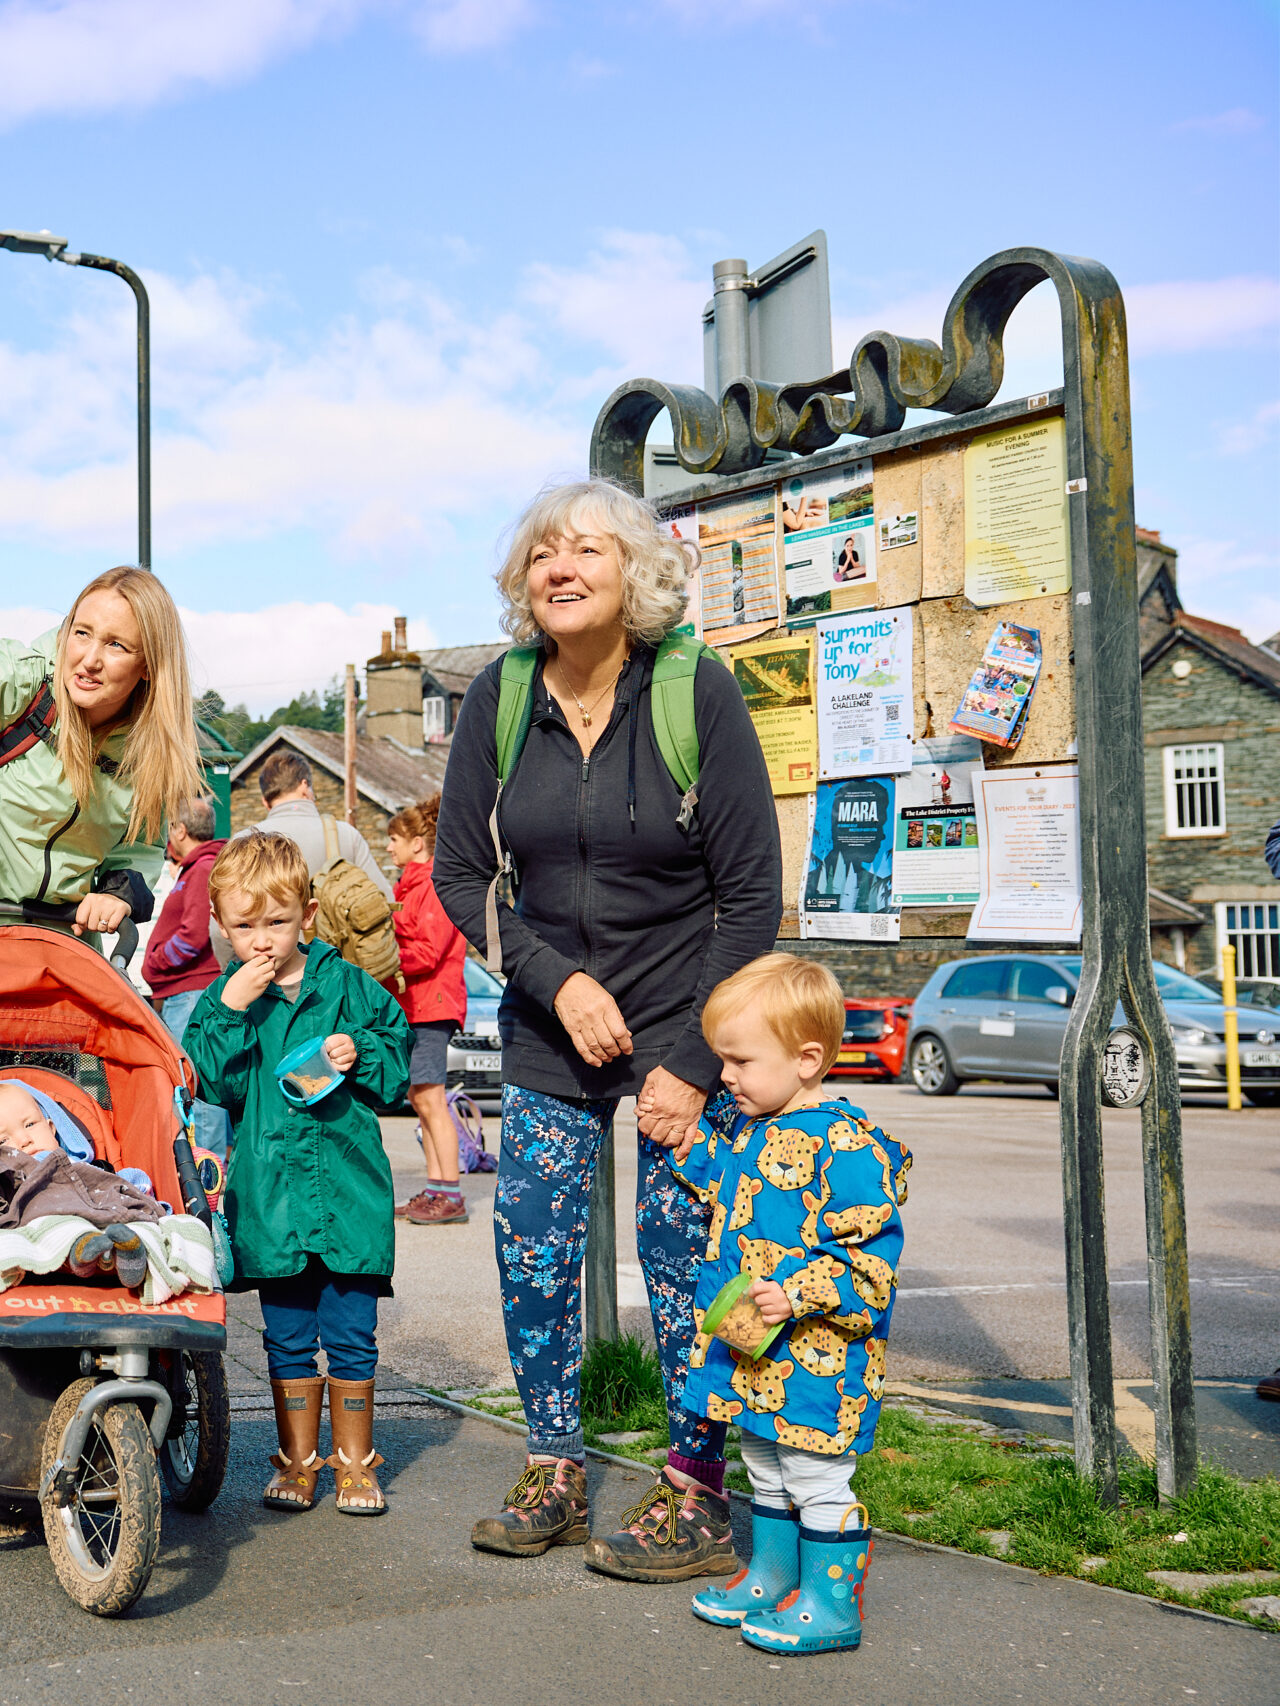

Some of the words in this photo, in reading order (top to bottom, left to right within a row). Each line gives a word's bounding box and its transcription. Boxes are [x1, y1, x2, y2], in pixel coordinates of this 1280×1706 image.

[986, 438, 1004, 449] MUSIC
[1004, 435, 1017, 444] FOR
[1022, 428, 1049, 440] SUMMER
[1005, 440, 1030, 451] EVENING
[791, 532, 807, 542] LEARN
[808, 528, 831, 539] MASSAGE
[838, 524, 848, 532] THE
[848, 520, 866, 530] LAKES
[767, 652, 800, 664] TITANIC
[824, 645, 842, 664] up
[848, 641, 872, 655] for
[824, 662, 861, 683] Tony
[832, 699, 871, 710] CHALLENGE
[837, 691, 873, 702] LAKELAND
[837, 801, 879, 822] MARA
[946, 807, 967, 815] Property
[5, 1295, 65, 1311] out
[98, 1297, 199, 1315] about
